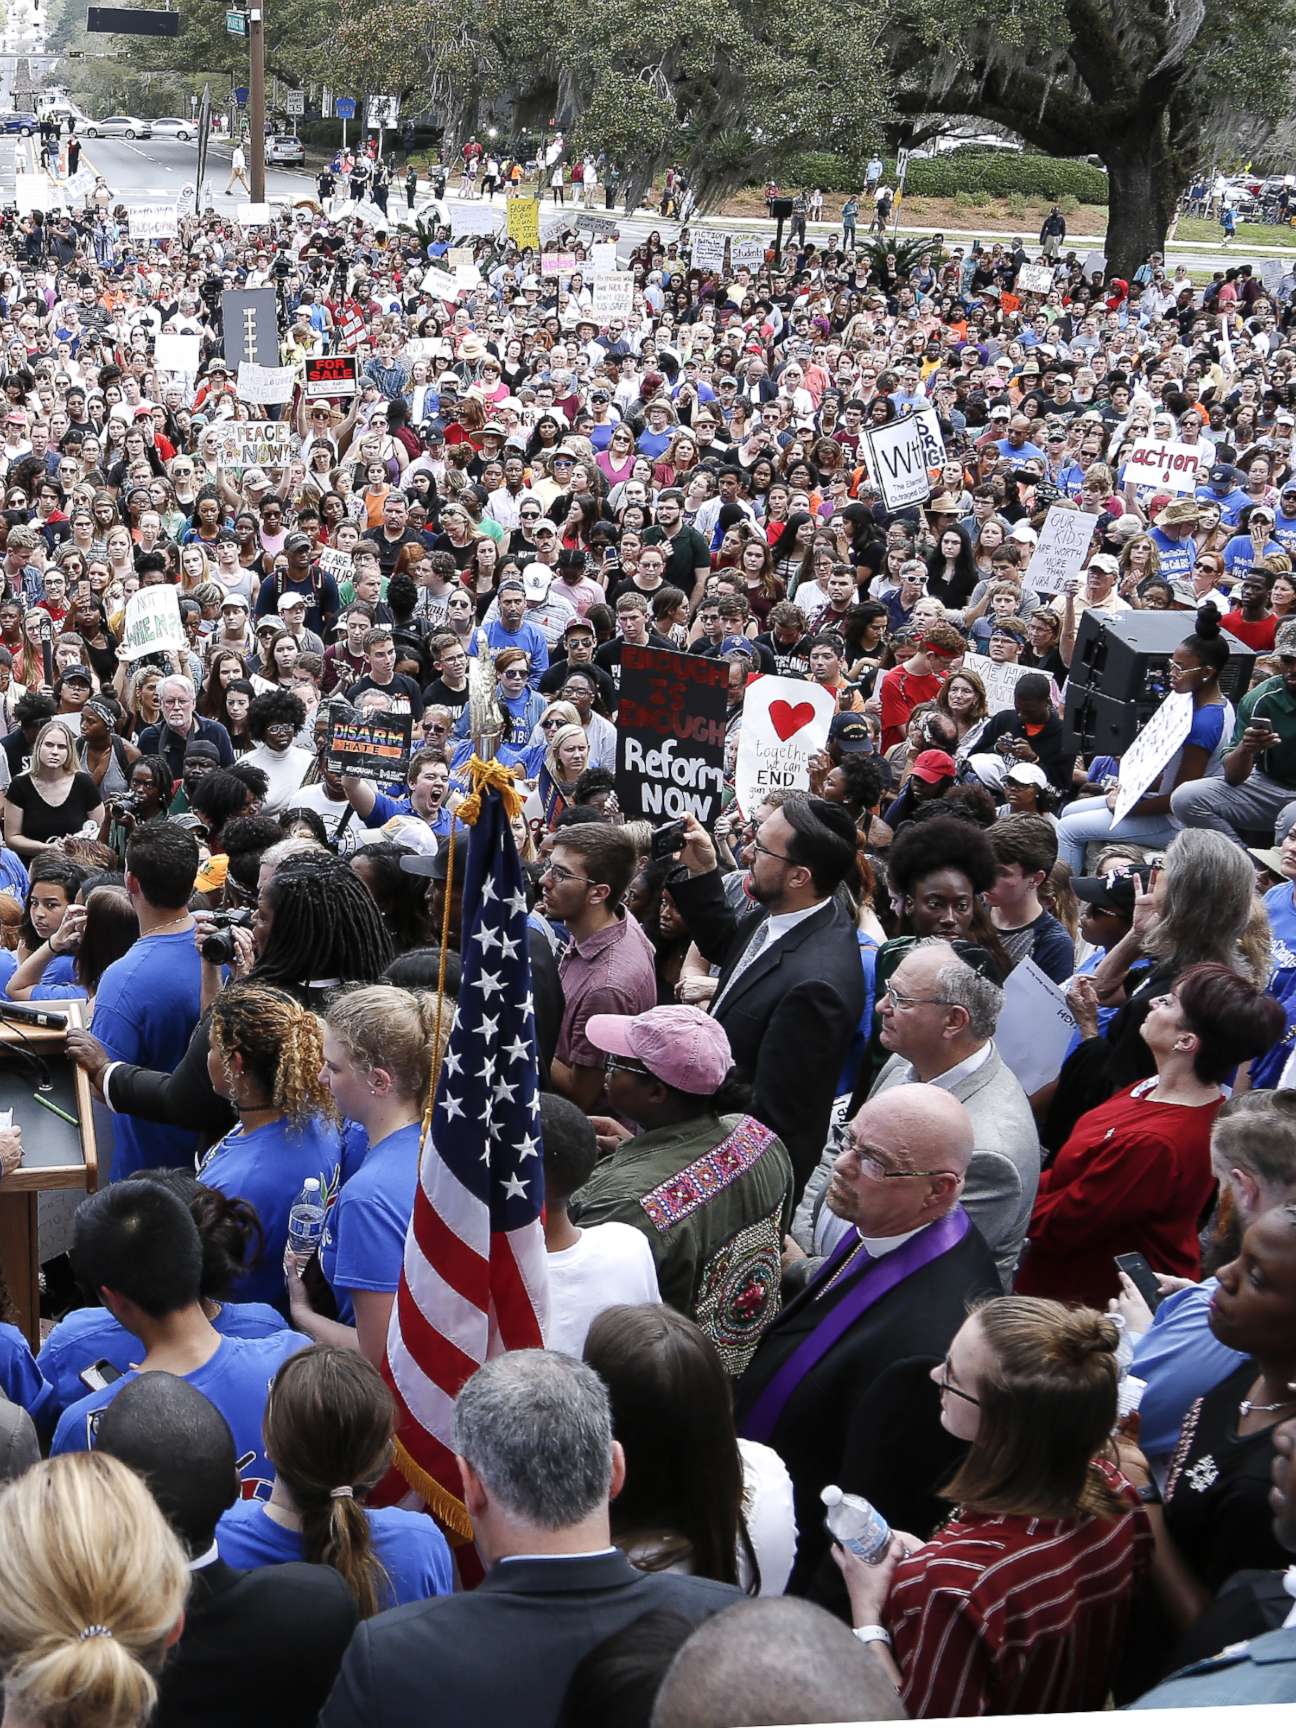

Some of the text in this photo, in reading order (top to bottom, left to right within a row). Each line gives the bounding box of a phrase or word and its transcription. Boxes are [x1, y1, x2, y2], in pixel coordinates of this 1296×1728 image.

[289, 105, 303, 113] 35
[694, 231, 726, 240] ACTION
[732, 248, 763, 257] Students
[315, 359, 345, 370] FOR
[308, 368, 354, 381] SALE
[237, 425, 285, 442] PEACE
[242, 443, 289, 464] NOW!
[1131, 445, 1200, 474] action
[1050, 513, 1074, 529] OUR
[1054, 529, 1085, 548] KIDS
[1036, 543, 1084, 559] ARE WORTH
[1043, 558, 1067, 569] MORE
[1046, 567, 1066, 578] THAN
[126, 613, 182, 649] WHEN?
[622, 647, 729, 689] ENOUGH
[969, 657, 1001, 681] WE
[649, 678, 688, 712] IS
[618, 698, 726, 747] ENOUGH
[333, 721, 405, 748] DISARM
[342, 742, 381, 754] HATE
[625, 737, 724, 793] Reform
[783, 761, 802, 774] can
[757, 770, 795, 787] END
[641, 782, 713, 822] NOW
